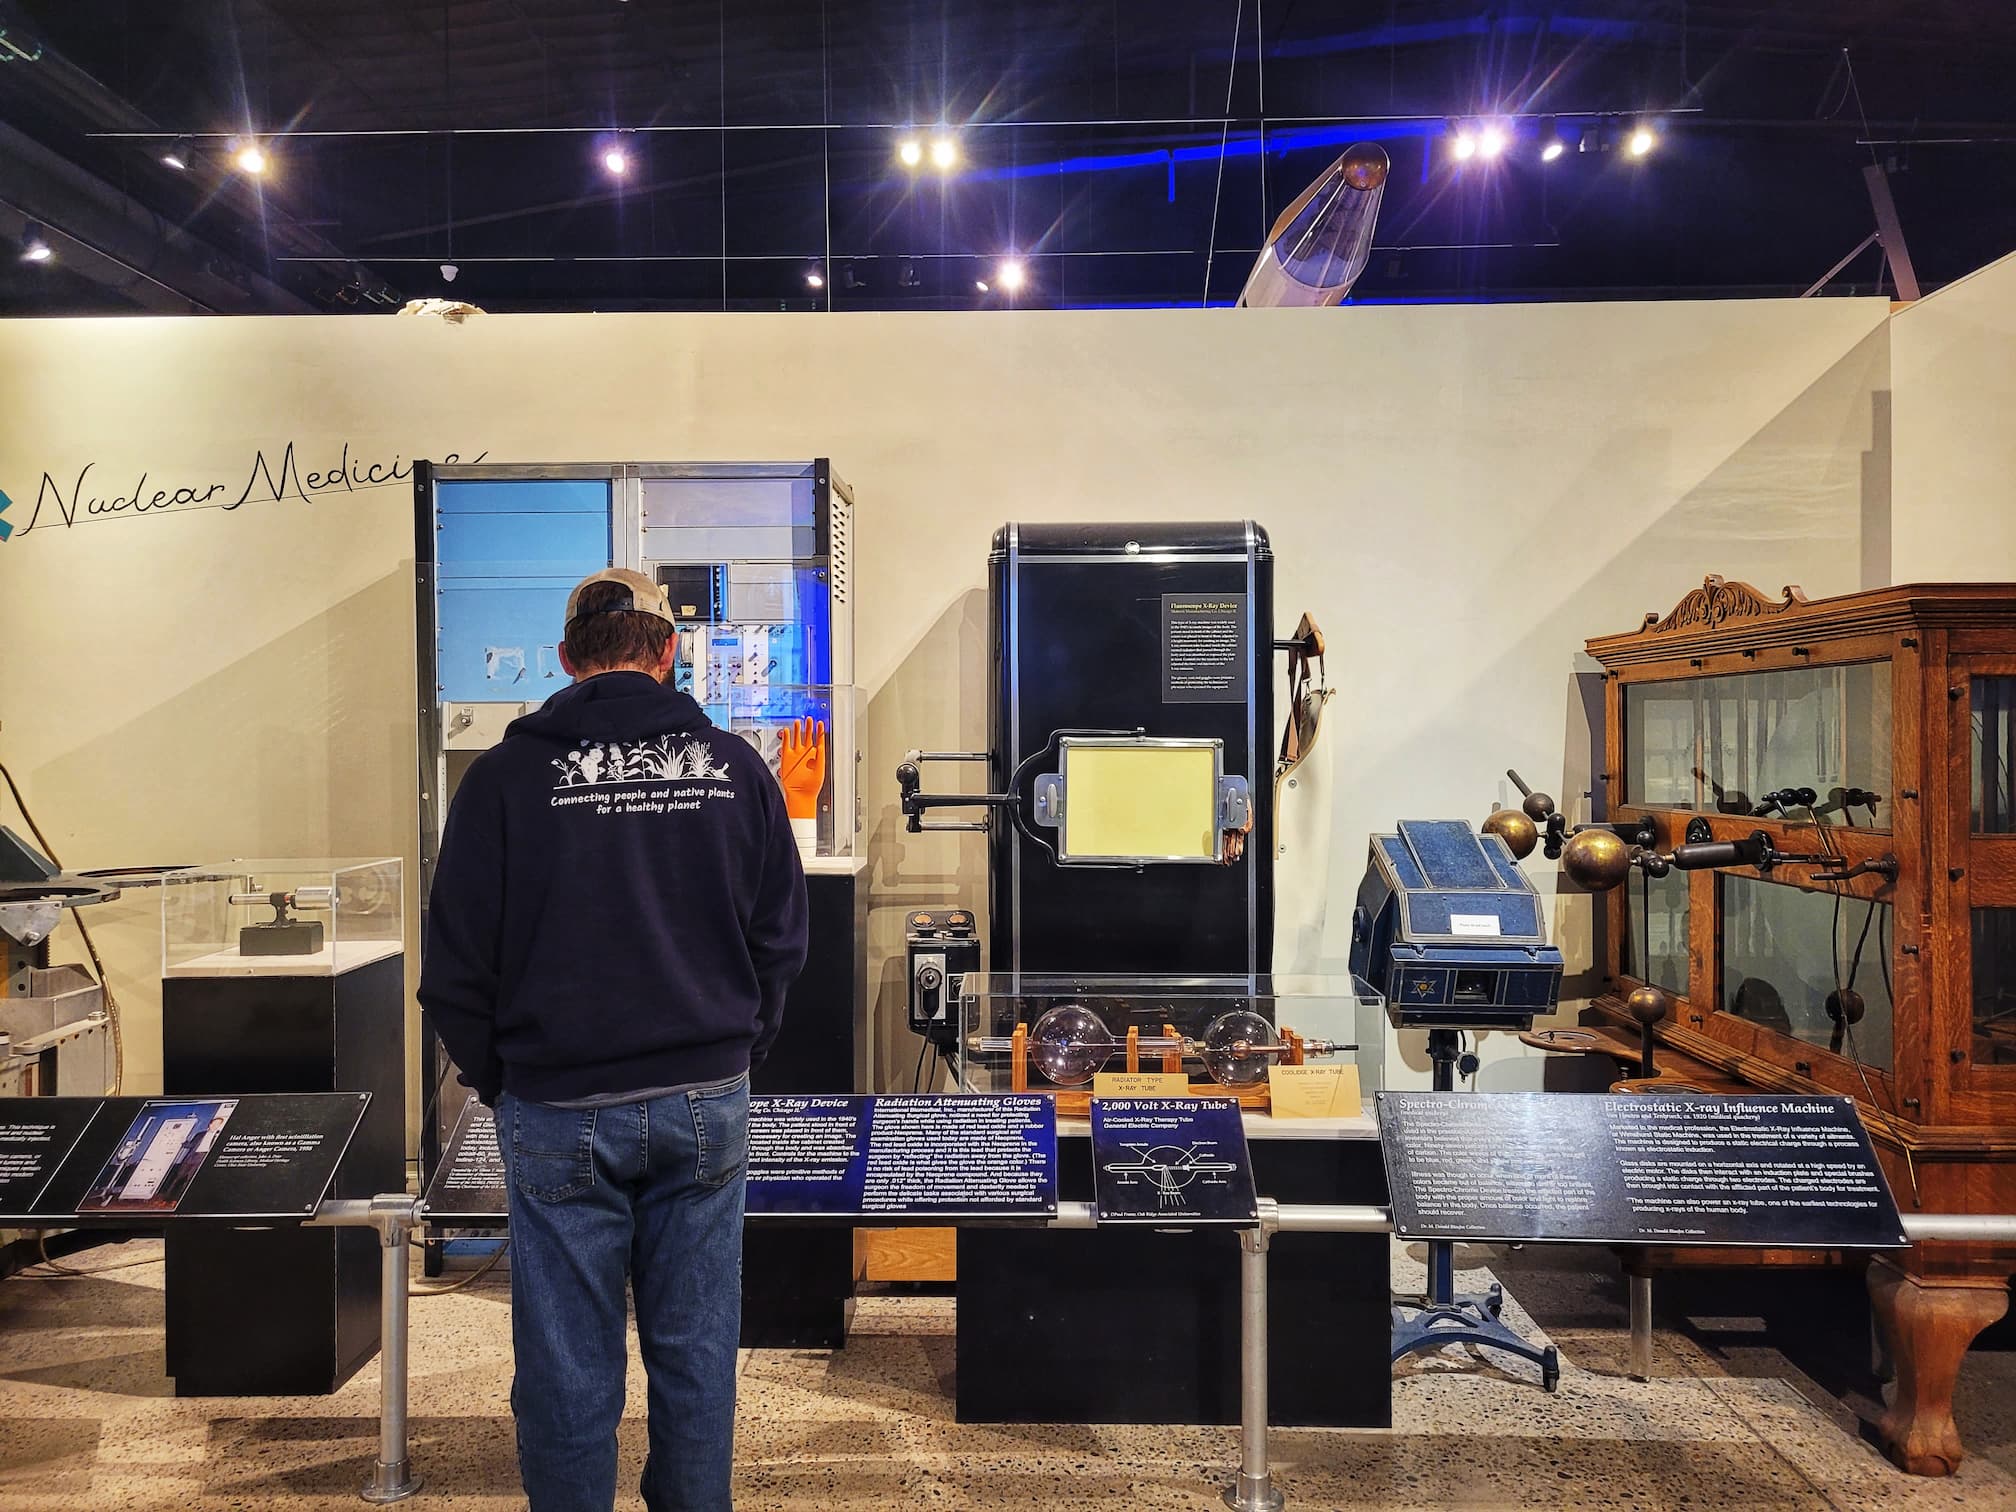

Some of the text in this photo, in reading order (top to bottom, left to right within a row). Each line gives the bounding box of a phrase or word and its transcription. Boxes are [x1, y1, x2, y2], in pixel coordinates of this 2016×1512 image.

[15, 441, 489, 536] Nuclear Medici
[551, 787, 735, 807] Connecting people and native plants
[596, 804, 611, 814] for
[626, 800, 664, 813] healthy
[668, 800, 701, 812] planet
[771, 1098, 808, 1110] X-Ray
[808, 1098, 849, 1107] Device
[874, 1097, 1042, 1109] Radiation Attenuating Gloves
[1102, 1101, 1228, 1113] 2,000 Volt X-Ray Tube
[1400, 1099, 1490, 1110] Spectro-Chrom
[1605, 1102, 1835, 1115] Electrostatic X-ray Influence Machine
